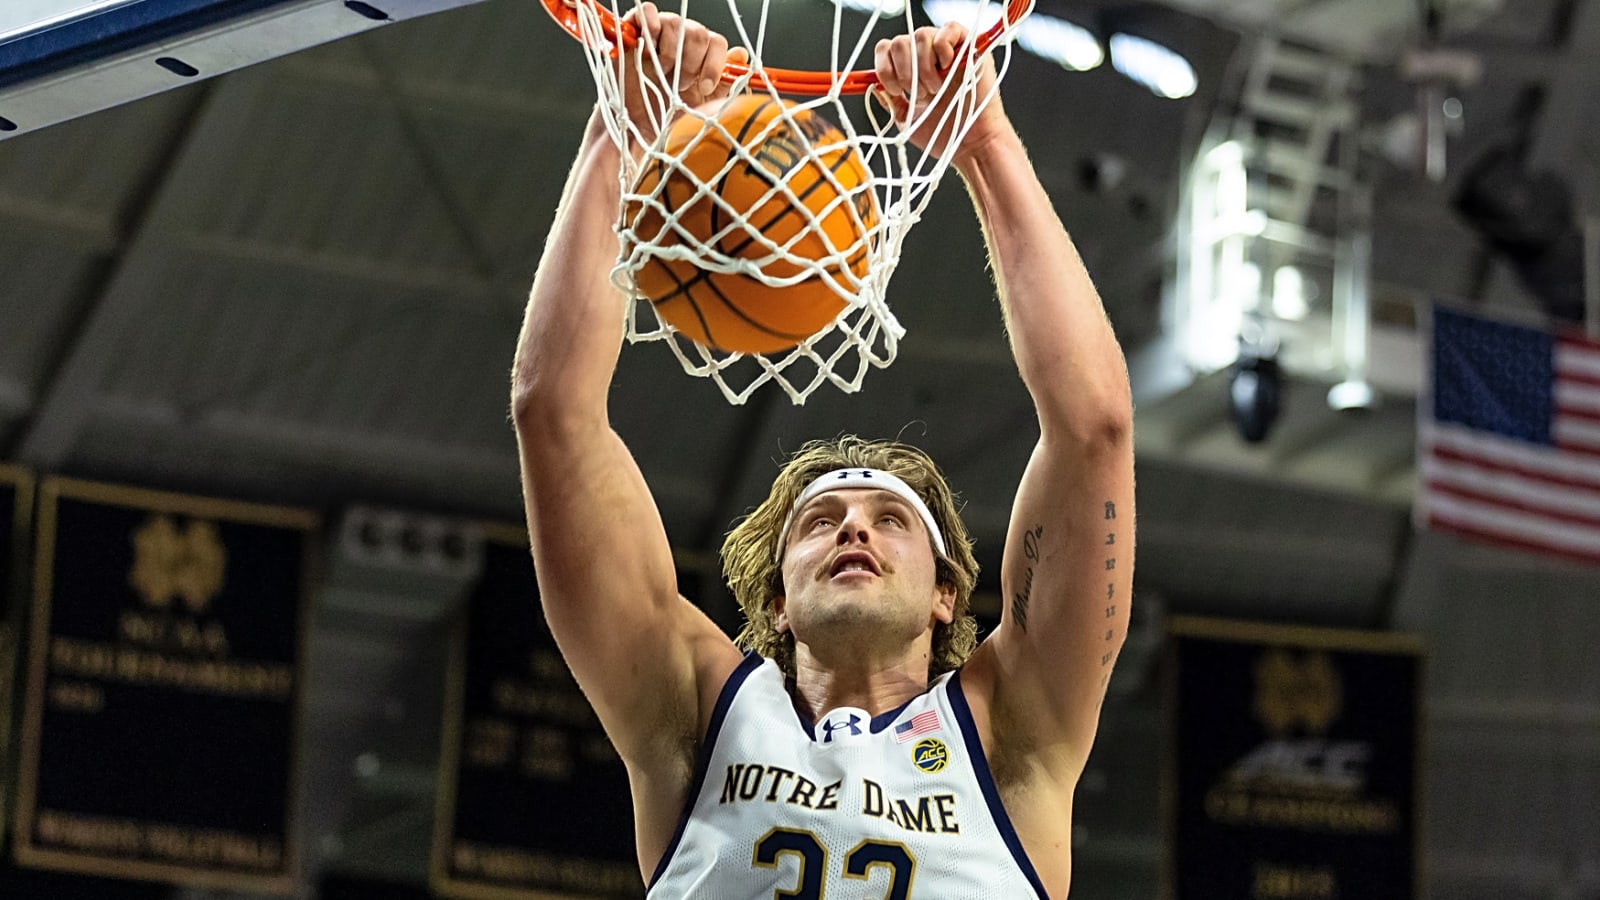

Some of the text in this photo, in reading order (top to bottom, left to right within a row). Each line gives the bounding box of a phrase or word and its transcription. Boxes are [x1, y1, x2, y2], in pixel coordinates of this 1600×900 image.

[918, 745, 945, 761] ACC
[719, 763, 960, 835] NOTRE DAME
